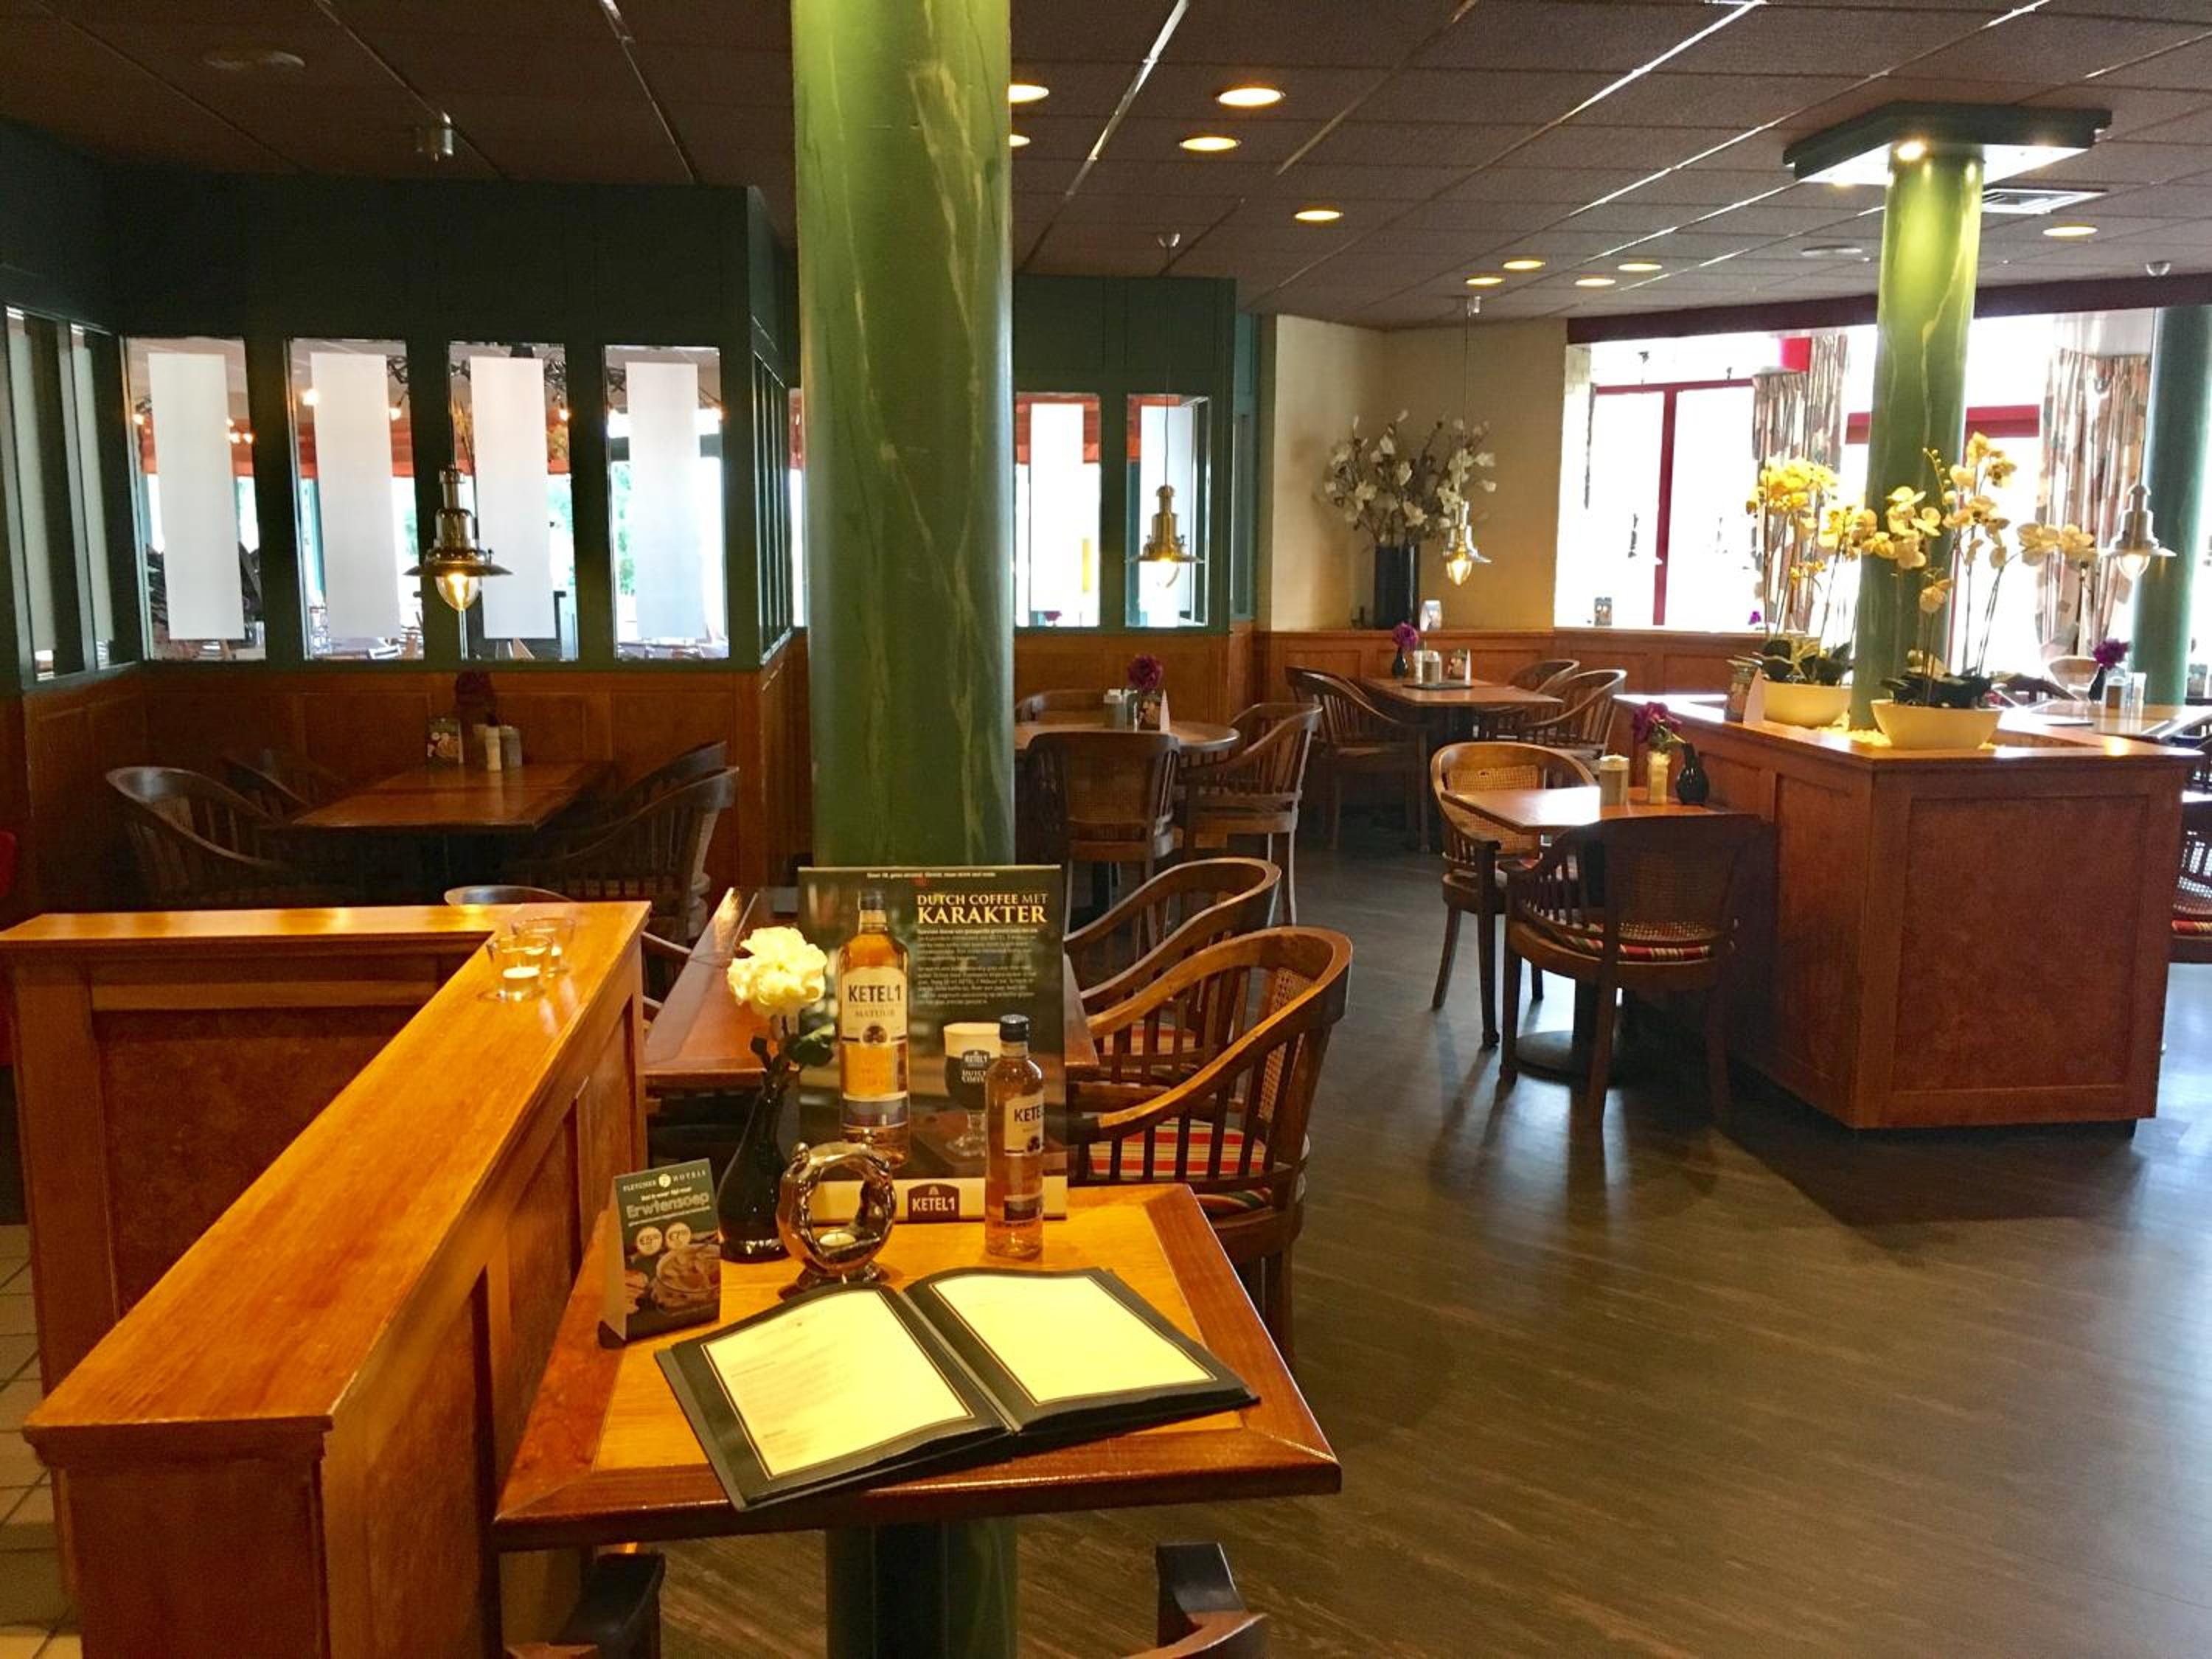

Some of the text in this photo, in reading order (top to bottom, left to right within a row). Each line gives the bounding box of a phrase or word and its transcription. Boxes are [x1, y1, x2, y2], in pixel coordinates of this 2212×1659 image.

[917, 894, 1048, 905] DUTCH COFFEE MET
[917, 905, 1048, 924] KARAKTER
[849, 984, 901, 1002] KETEL1
[626, 1192, 709, 1219] Erwtensoep
[912, 1196, 955, 1211] KETEL1
